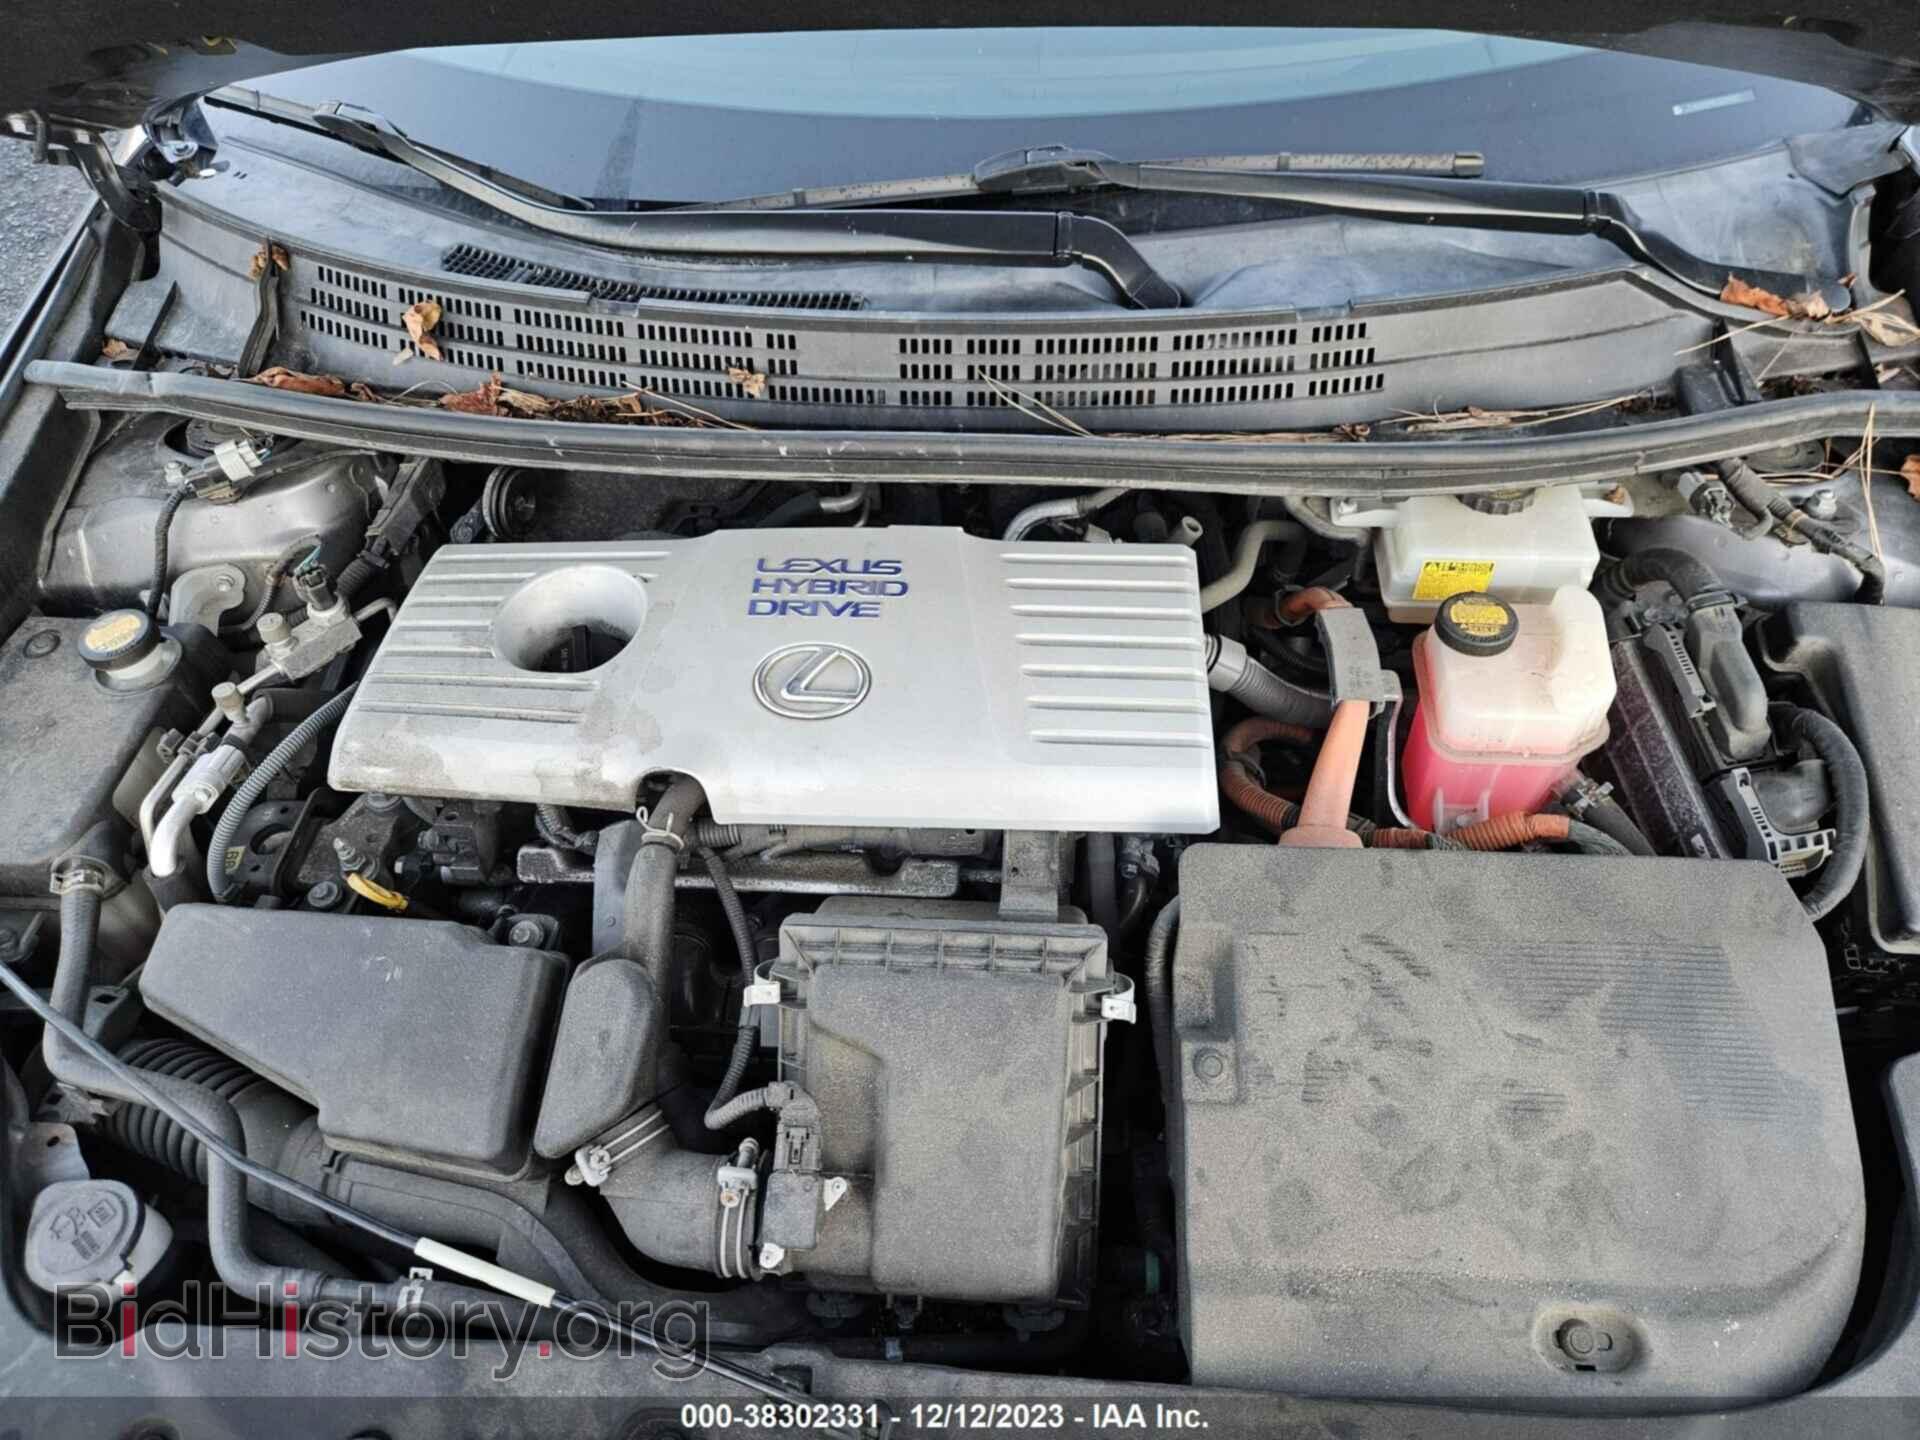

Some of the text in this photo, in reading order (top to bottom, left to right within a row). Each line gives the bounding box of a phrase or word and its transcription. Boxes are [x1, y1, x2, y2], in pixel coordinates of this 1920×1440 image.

[757, 558, 903, 575] LEXUS
[752, 578, 909, 597] HYBRID
[748, 599, 881, 618] DRIVE
